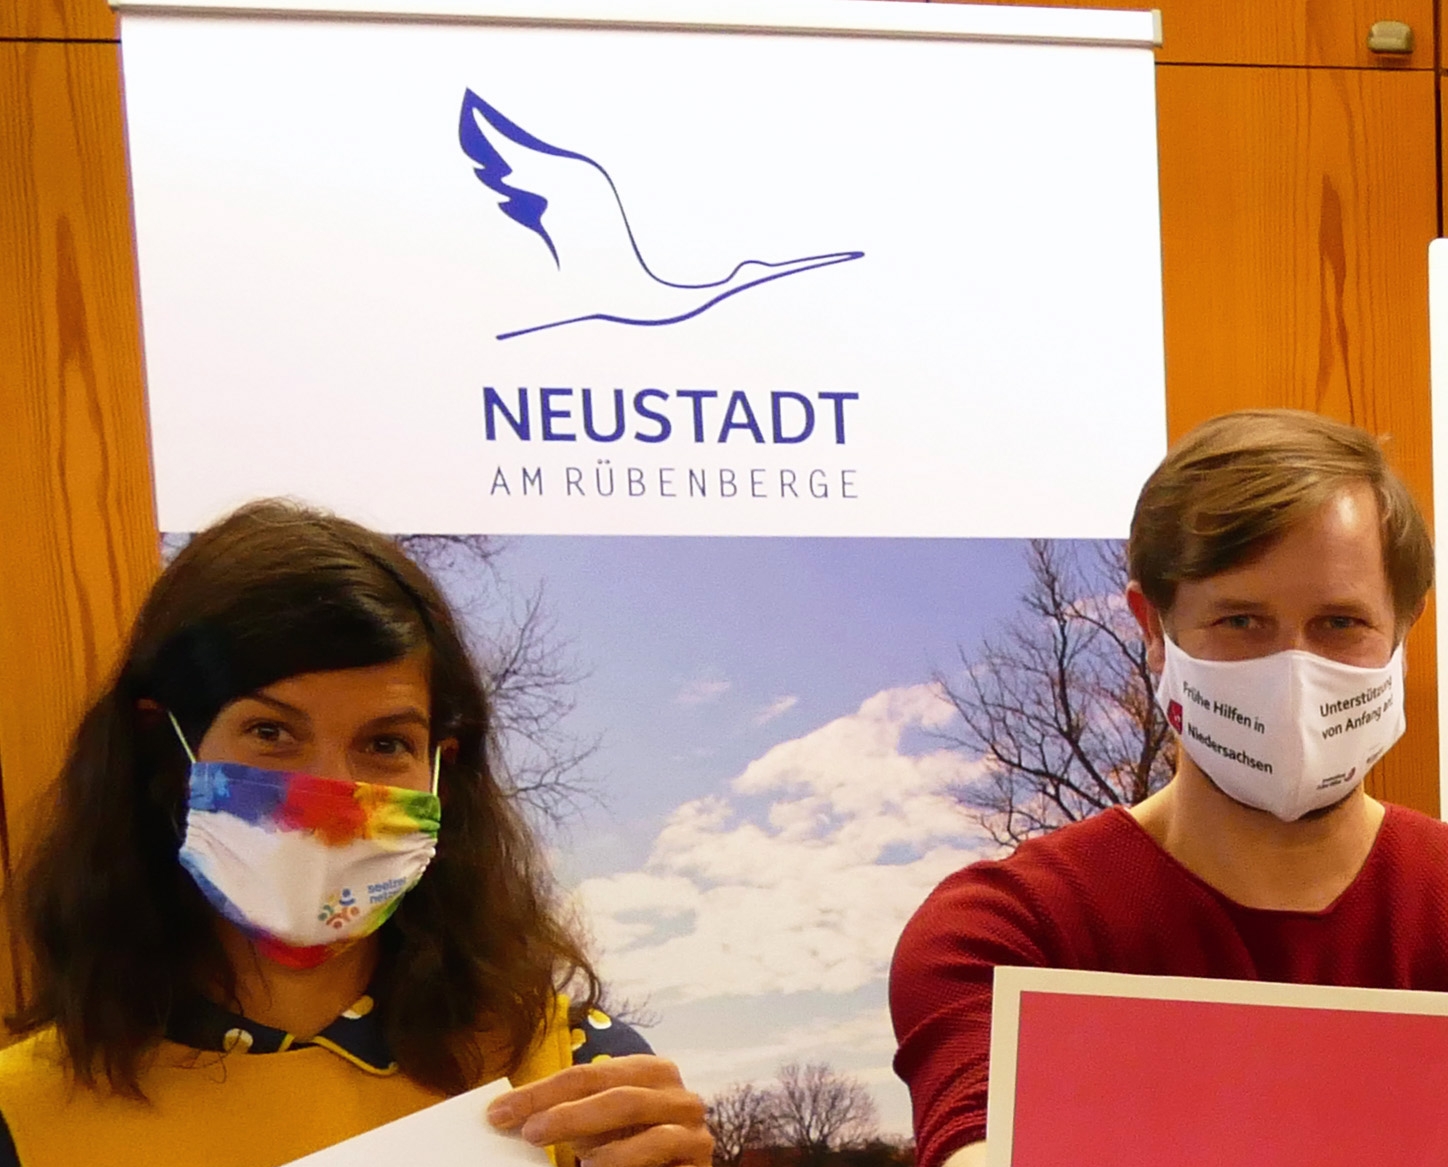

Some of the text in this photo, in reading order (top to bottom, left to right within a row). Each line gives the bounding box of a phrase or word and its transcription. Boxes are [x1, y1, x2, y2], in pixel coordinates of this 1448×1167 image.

[483, 386, 859, 445] NEUSTADT
[490, 459, 858, 499] AM RÜBENBERGE
[1213, 701, 1251, 728] Hilfen
[1254, 716, 1265, 734] in
[1322, 723, 1342, 740] von
[1345, 706, 1381, 732] Anfang
[1188, 722, 1273, 775] Niedersachsen
